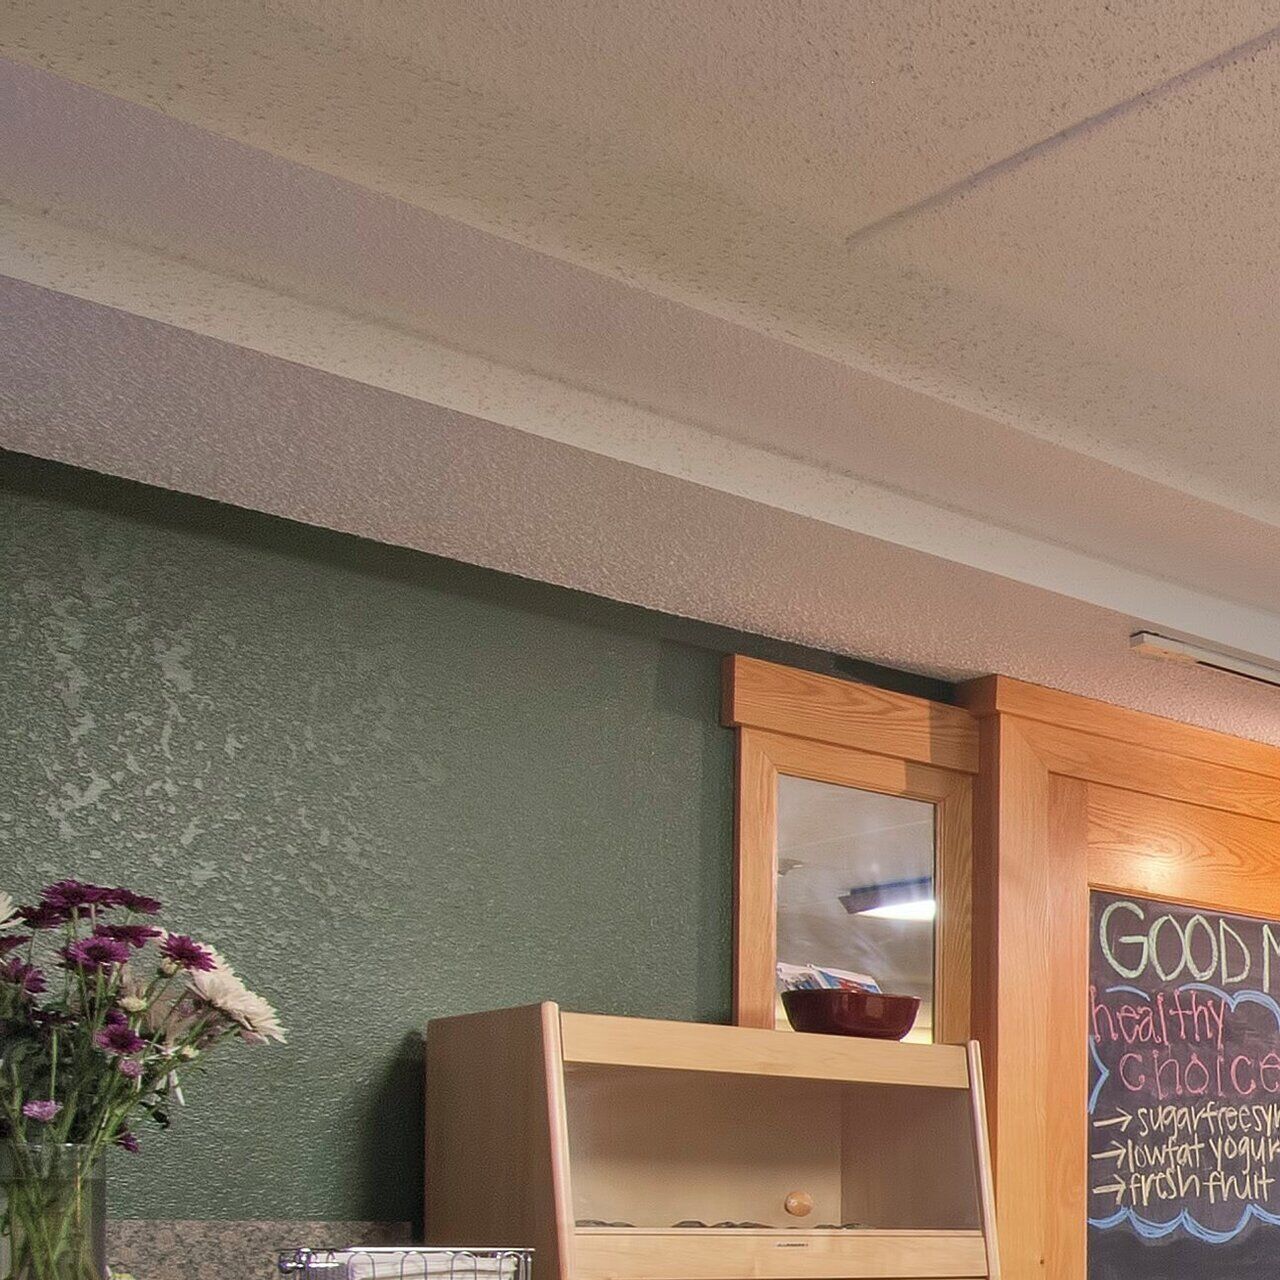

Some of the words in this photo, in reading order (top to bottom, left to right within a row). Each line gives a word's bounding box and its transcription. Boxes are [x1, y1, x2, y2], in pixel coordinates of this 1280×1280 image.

[1099, 900, 1252, 986] GOOD
[1089, 984, 1227, 1051] healthy
[1128, 1165, 1201, 1206] fresh
[1201, 1165, 1277, 1204] fruit
